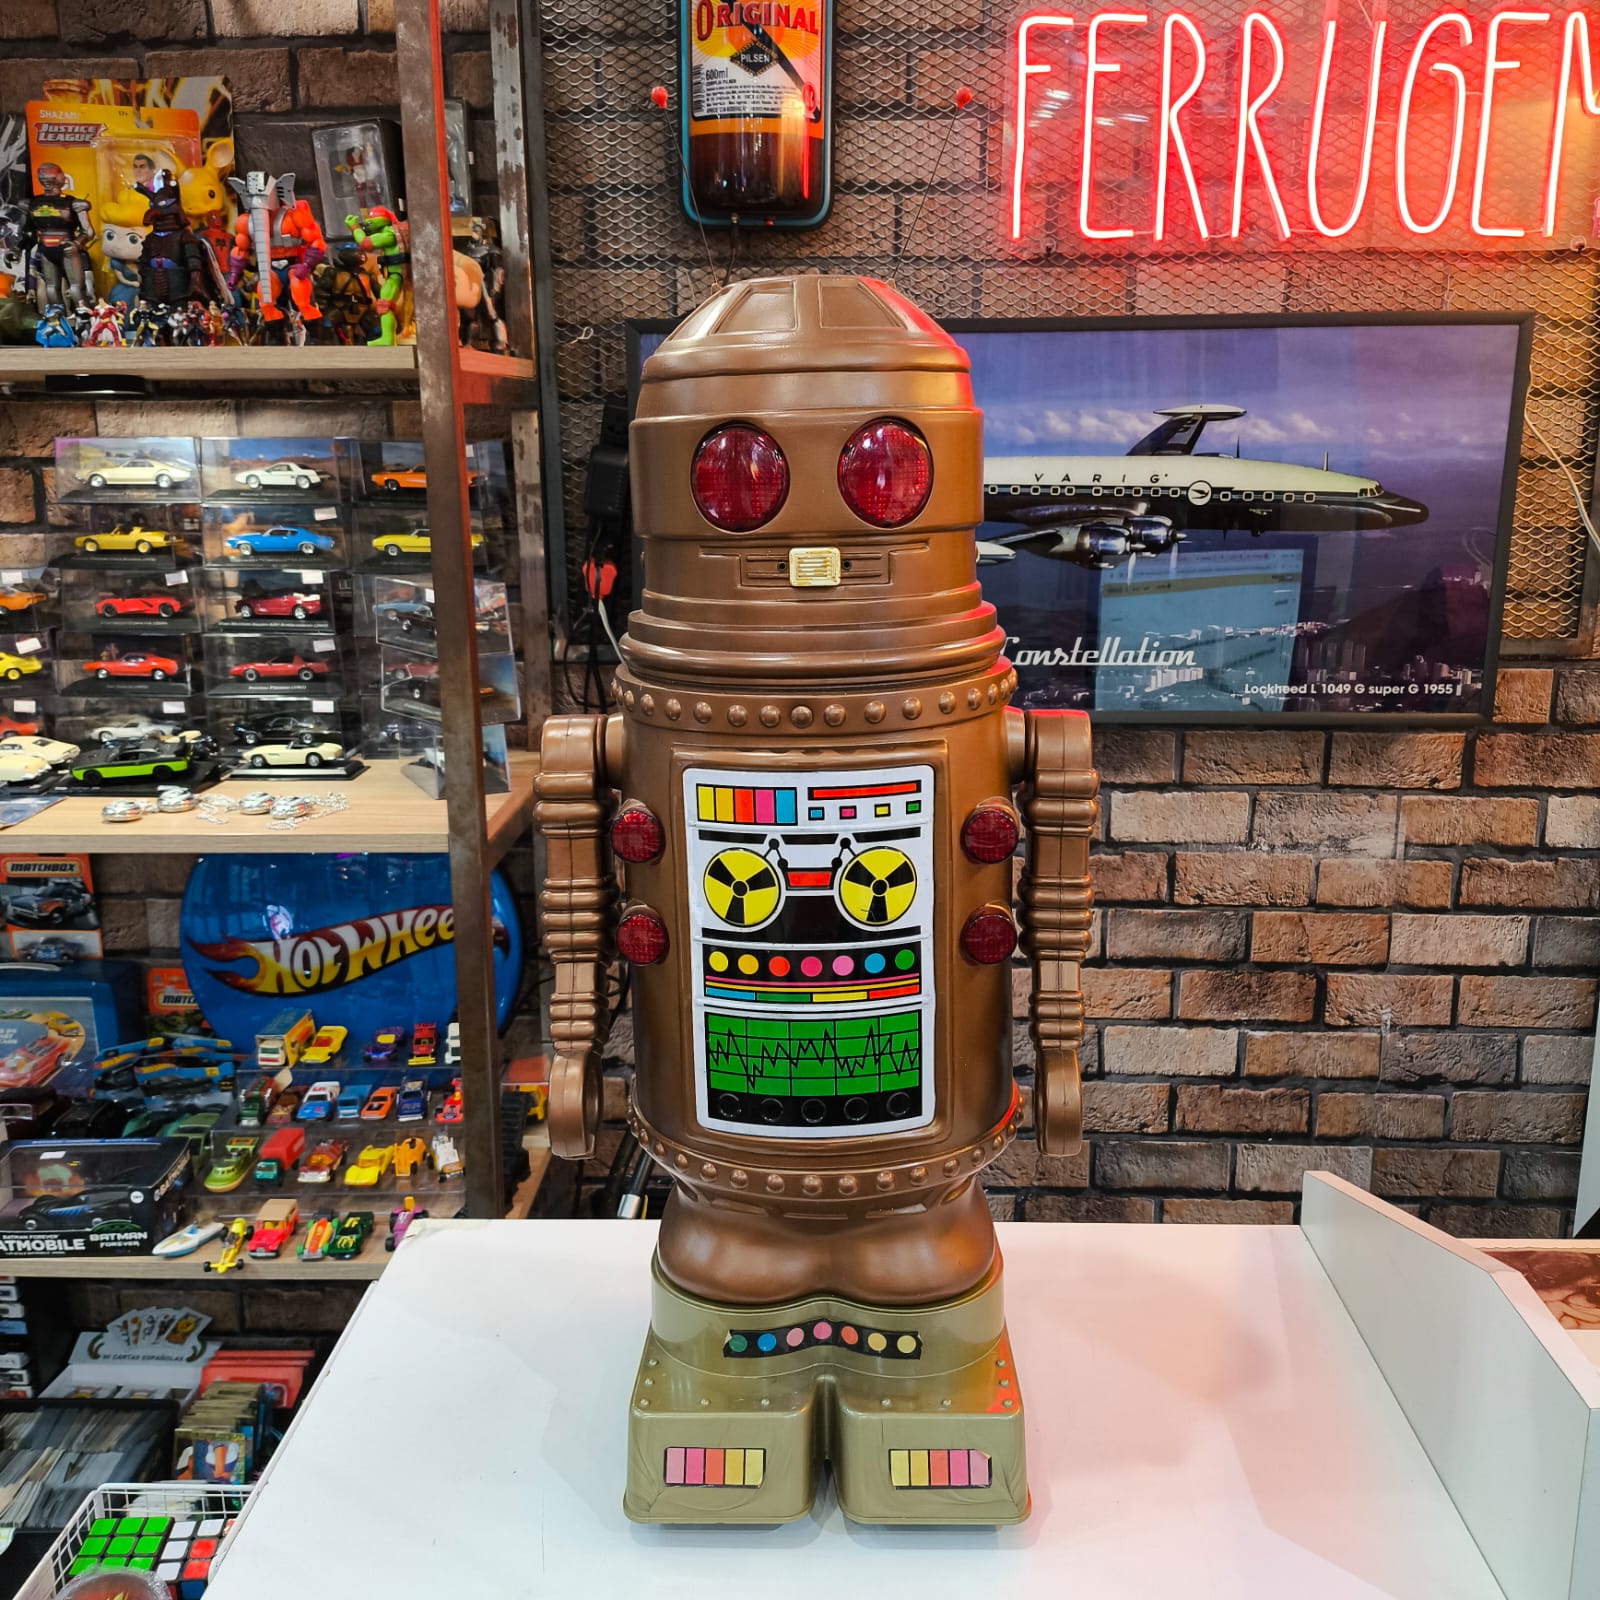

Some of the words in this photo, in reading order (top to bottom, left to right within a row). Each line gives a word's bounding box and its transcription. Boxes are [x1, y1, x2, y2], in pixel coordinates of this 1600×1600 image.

[696, 0, 819, 41] ORIGINAL
[740, 54, 770, 63] PILSEN
[42, 123, 97, 133] JUSTICE
[38, 132, 95, 142] LEAGUE
[1001, 636, 1197, 666] Constellation
[1244, 683, 1307, 696] Lockheed
[1311, 683, 1317, 694] L
[1322, 683, 1351, 694] 1049
[1354, 683, 1365, 694] G
[1368, 685, 1405, 697] super
[1408, 684, 1419, 695] G
[1424, 684, 1453, 695] 1955
[10, 863, 76, 872] MATCHBOX
[90, 1232, 148, 1243] BATMAN
